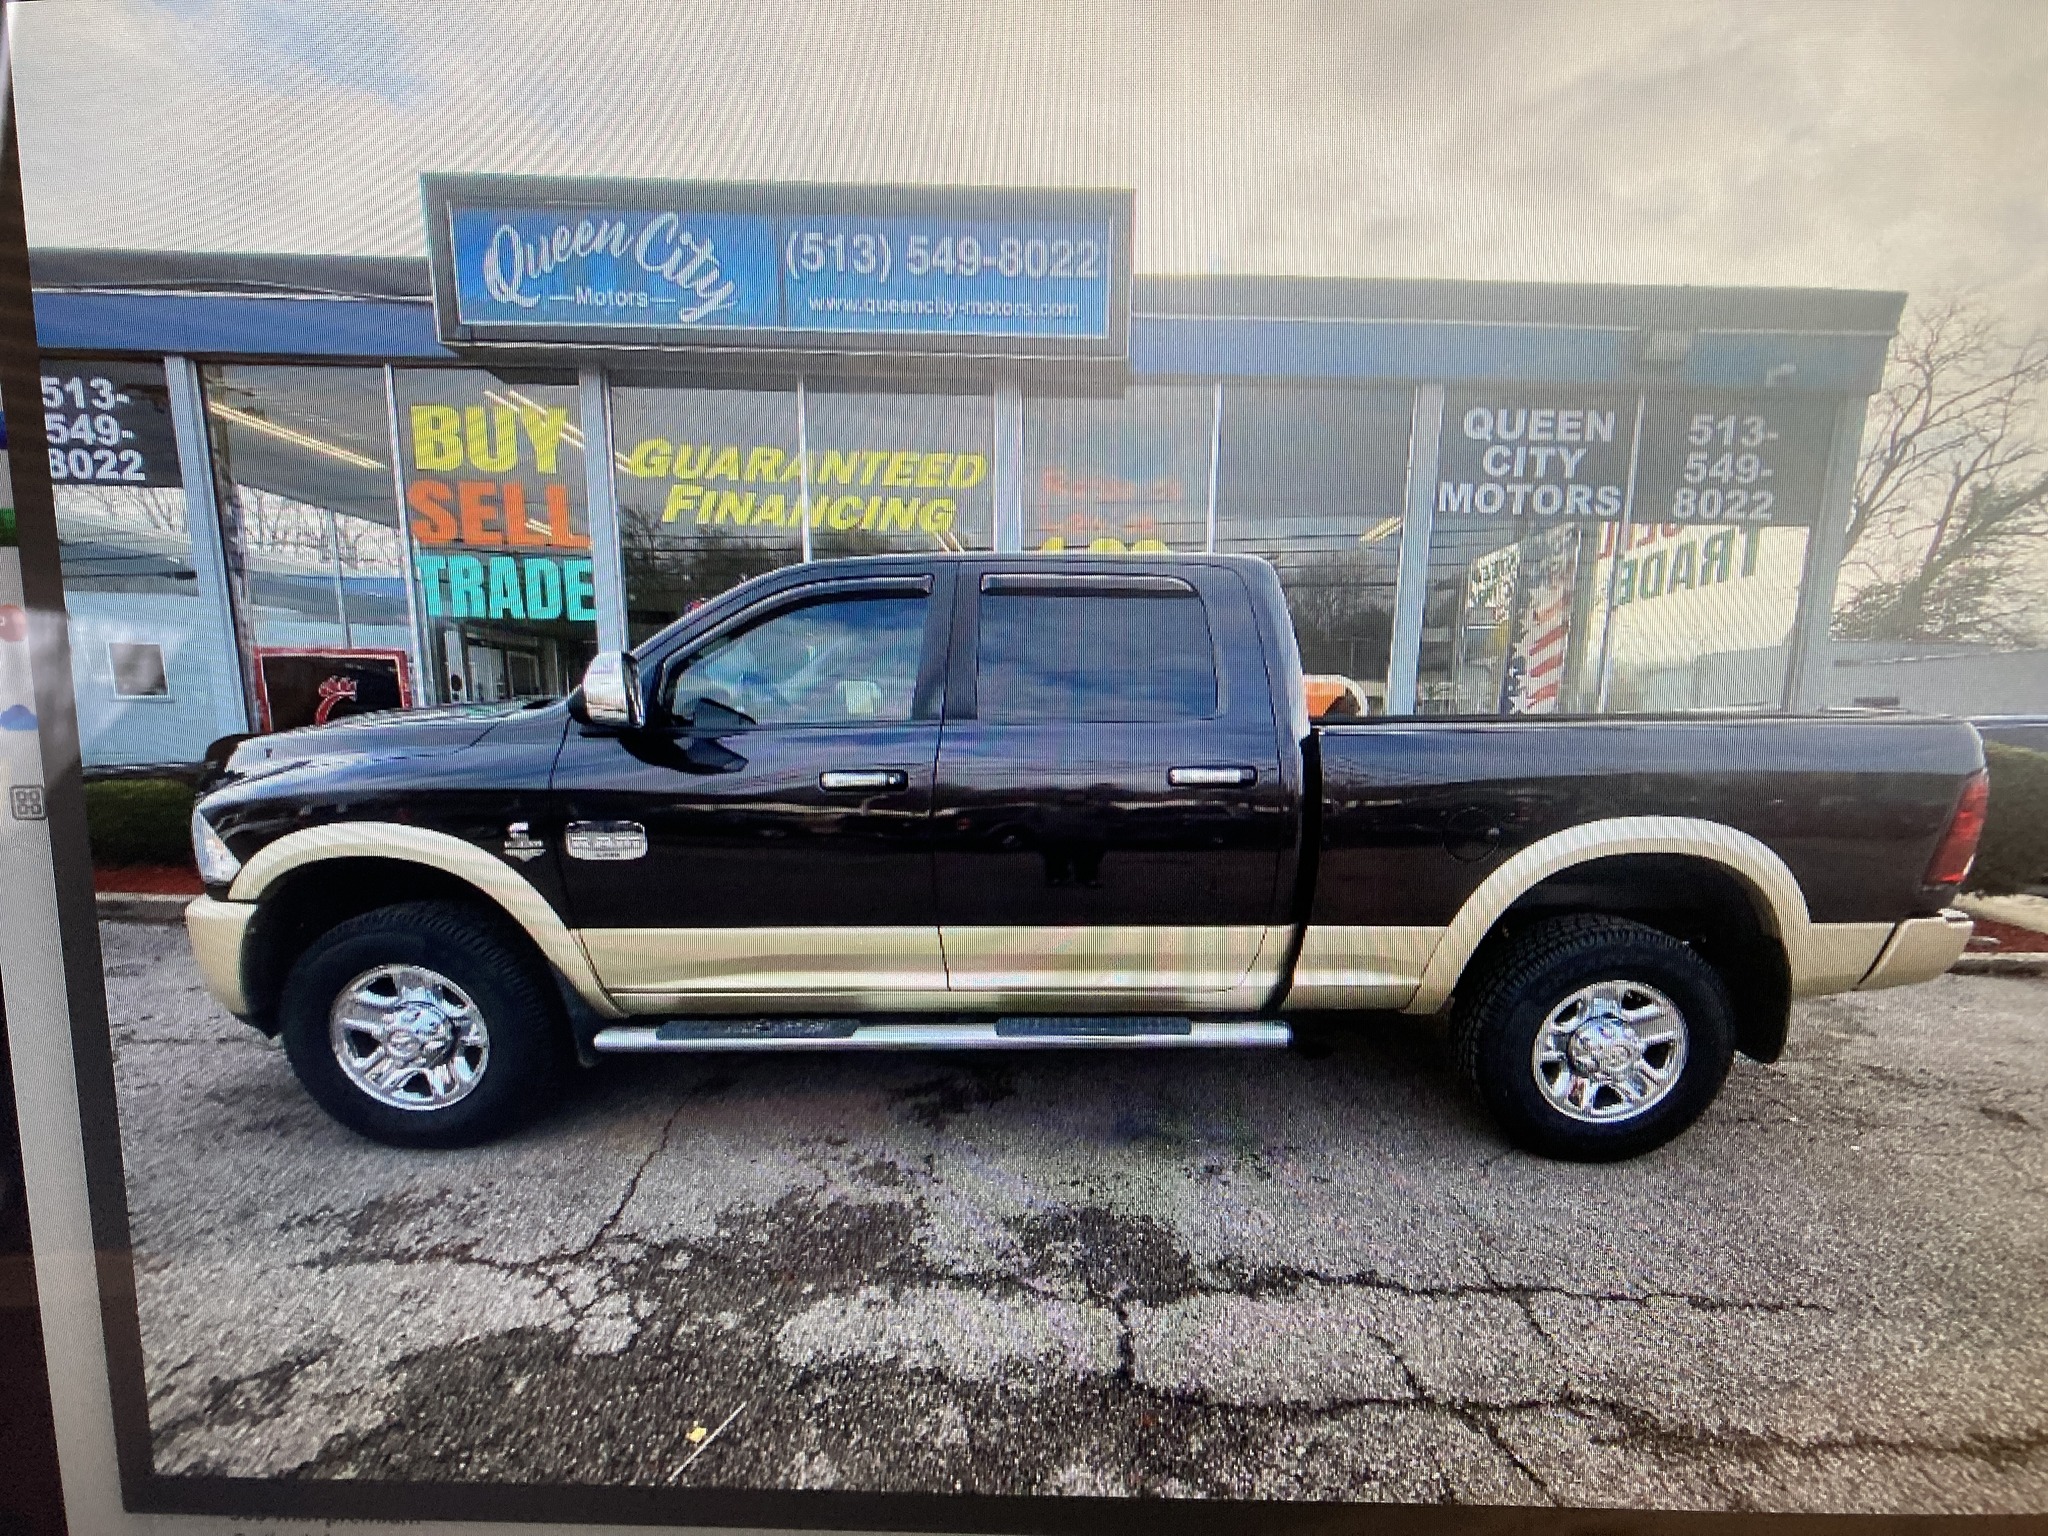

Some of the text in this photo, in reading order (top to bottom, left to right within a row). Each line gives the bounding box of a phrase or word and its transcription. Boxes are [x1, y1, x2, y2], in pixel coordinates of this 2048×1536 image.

[483, 206, 737, 323] Queen City
[787, 231, 1099, 283] (513) 549-8022
[574, 286, 648, 308] Motors
[809, 296, 1078, 319] www.queencity-motors.com
[40, 375, 130, 410] 513-
[44, 412, 134, 446] 549-
[410, 404, 568, 474] BUY
[1463, 407, 1616, 443] QUEEN
[1687, 412, 1780, 448] 513-
[48, 447, 146, 480] 8022
[628, 437, 988, 489] GUARANTEED
[1482, 445, 1587, 480] CITY
[1683, 451, 1774, 486] 549-
[407, 479, 592, 548] SELL
[662, 484, 956, 533] FINANCING
[1437, 481, 1622, 517] MOTORS
[1671, 488, 1775, 522] 8022
[415, 554, 597, 621] TRADE
